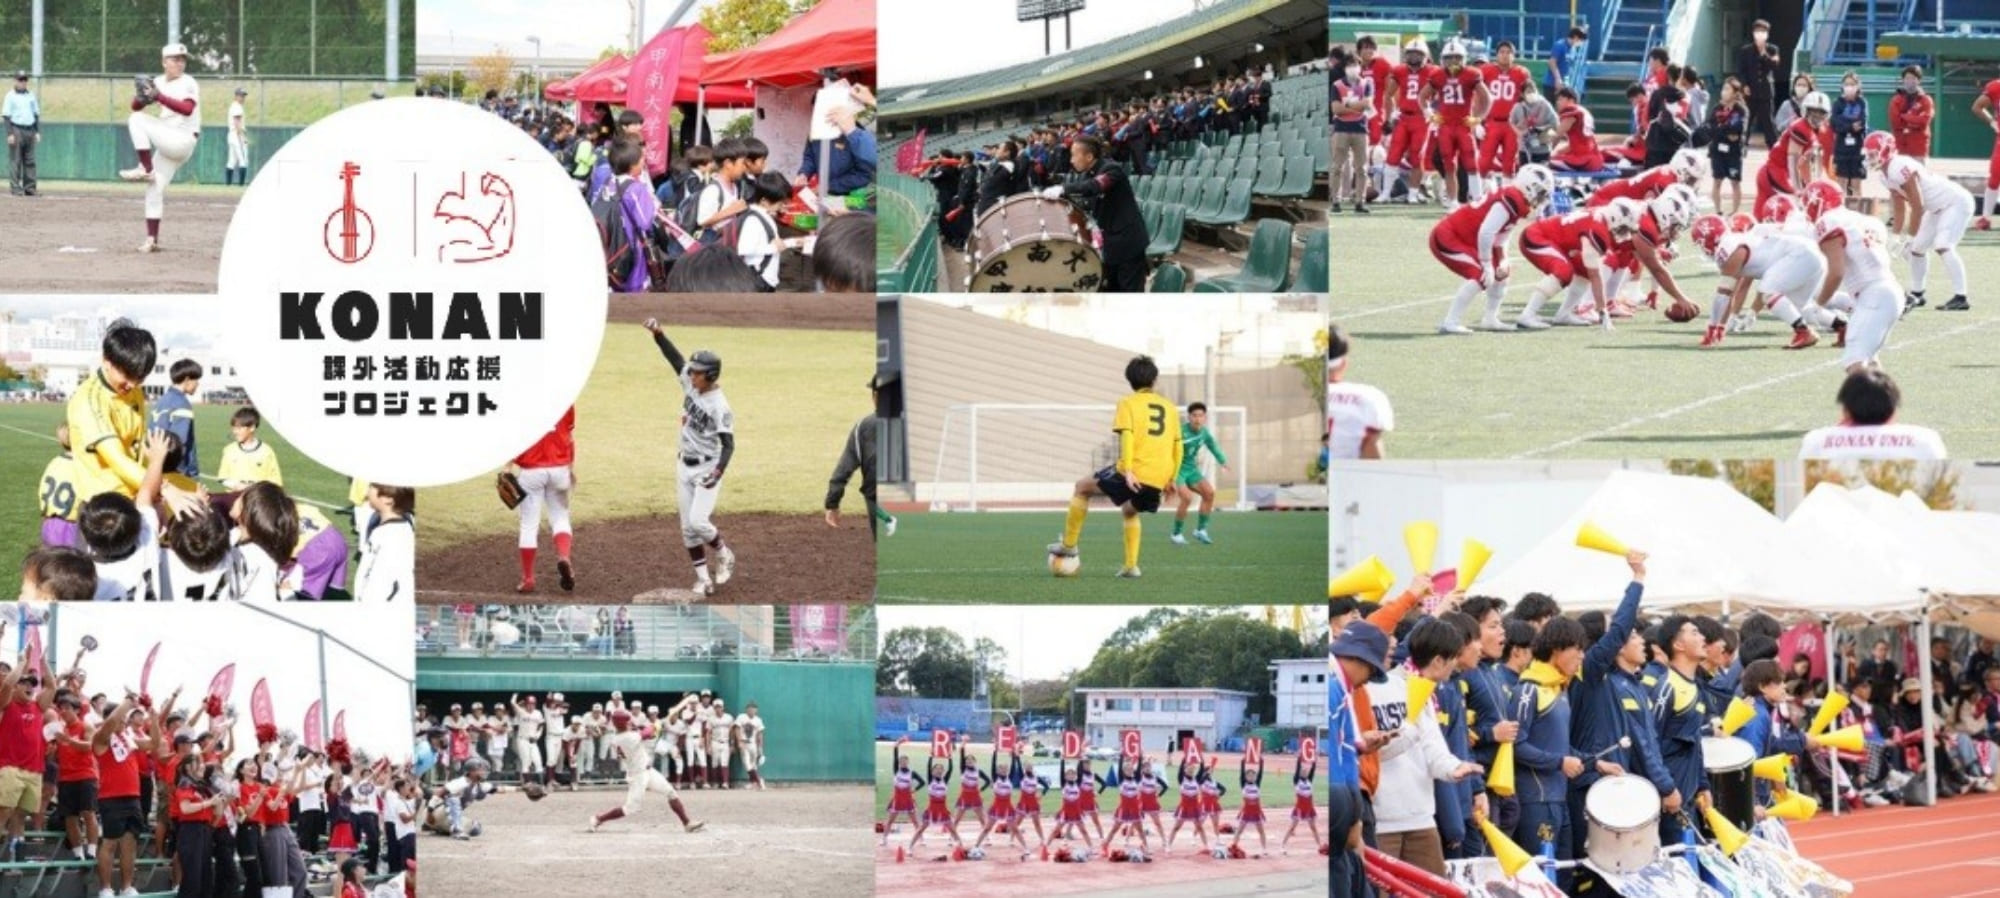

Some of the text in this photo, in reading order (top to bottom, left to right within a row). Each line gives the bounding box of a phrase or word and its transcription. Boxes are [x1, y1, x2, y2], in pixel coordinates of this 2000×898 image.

[1406, 80, 1419, 100] 2
[1443, 85, 1465, 104] 21
[1490, 80, 1516, 100] 90
[1147, 403, 1166, 436] 3
